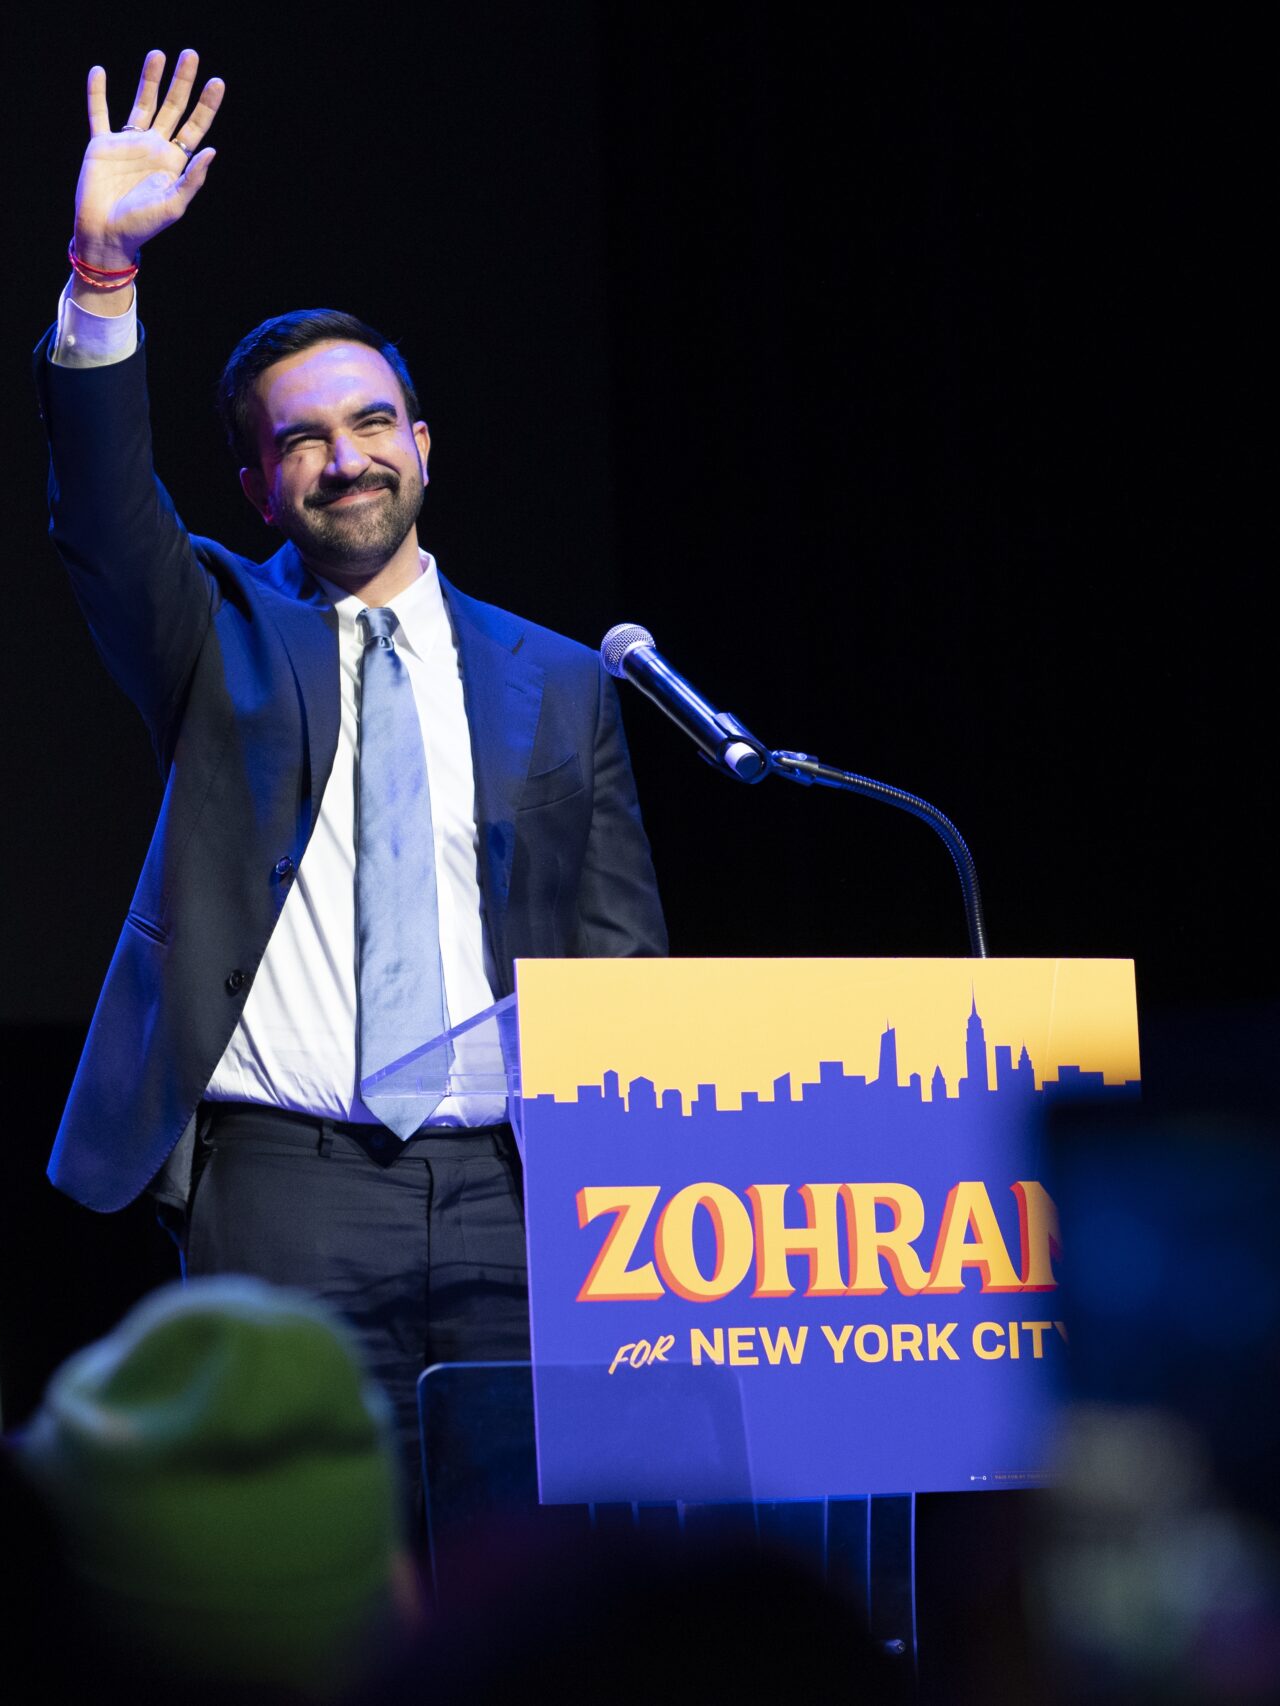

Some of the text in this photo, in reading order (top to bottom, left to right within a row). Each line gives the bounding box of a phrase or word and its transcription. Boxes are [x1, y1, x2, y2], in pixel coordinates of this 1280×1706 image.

[608, 1320, 1070, 1375] FOR NEW YORK CIT
